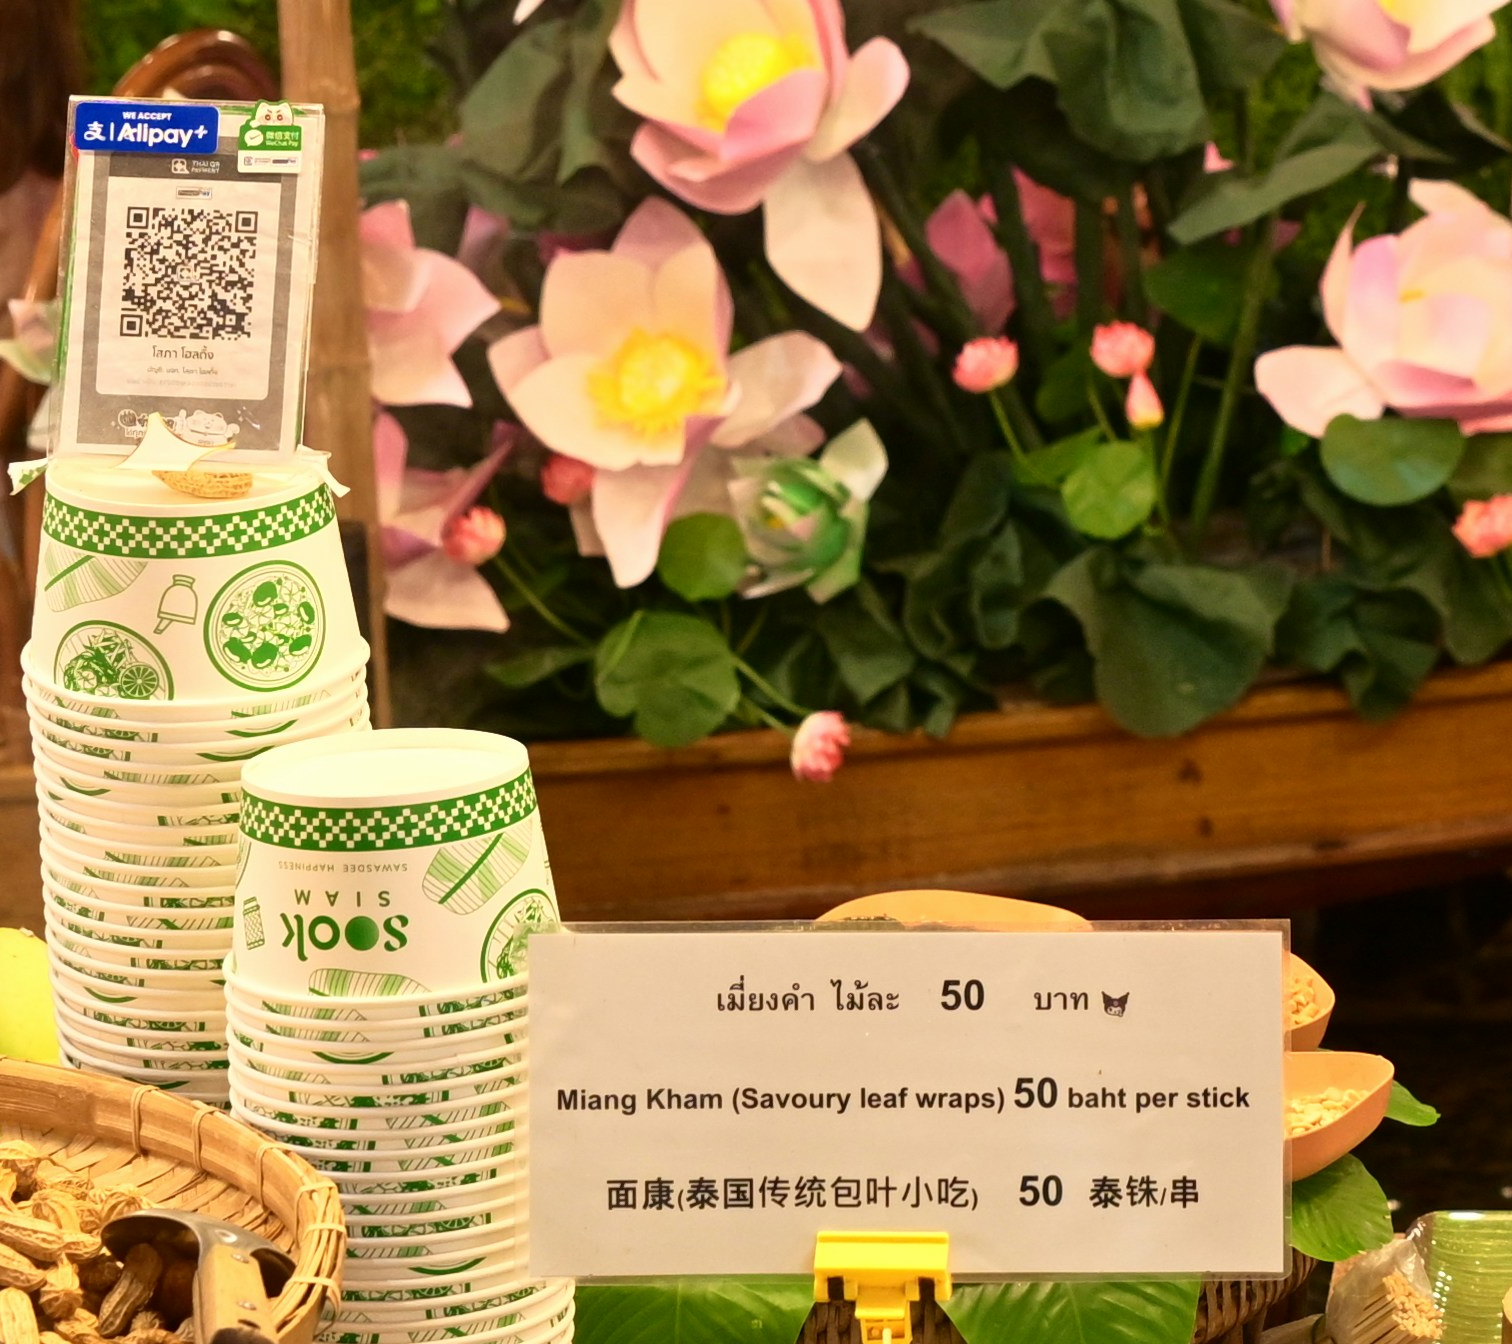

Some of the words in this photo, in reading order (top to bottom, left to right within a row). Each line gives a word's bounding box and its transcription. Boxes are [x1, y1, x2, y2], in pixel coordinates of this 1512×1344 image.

[122, 111, 137, 120] WE
[138, 112, 172, 121] ACCEPT
[117, 122, 209, 148] Alipay+
[278, 860, 335, 872] HAPPINESS
[343, 863, 408, 873] SAWASDEE
[294, 889, 391, 908] SIAM
[717, 974, 816, 1011] เมี่ยงคำ
[830, 978, 900, 1011] ไม้ละ
[940, 979, 986, 1011] 50
[1033, 990, 1090, 1012] บาท
[557, 1088, 637, 1116] Miang
[647, 1088, 723, 1110] Kham
[732, 1087, 852, 1115] (Savoury
[860, 1087, 909, 1109] leaf
[915, 1087, 1006, 1115] wraps)
[1014, 1077, 1058, 1109] 50
[1068, 1087, 1127, 1109] baht
[1135, 1092, 1179, 1114] per
[1186, 1086, 1250, 1109] stick
[606, 1175, 979, 1211] 面康(泰国传统包叶小吃)
[1018, 1175, 1064, 1207] 50
[1089, 1175, 1200, 1208] 泰铢/串
